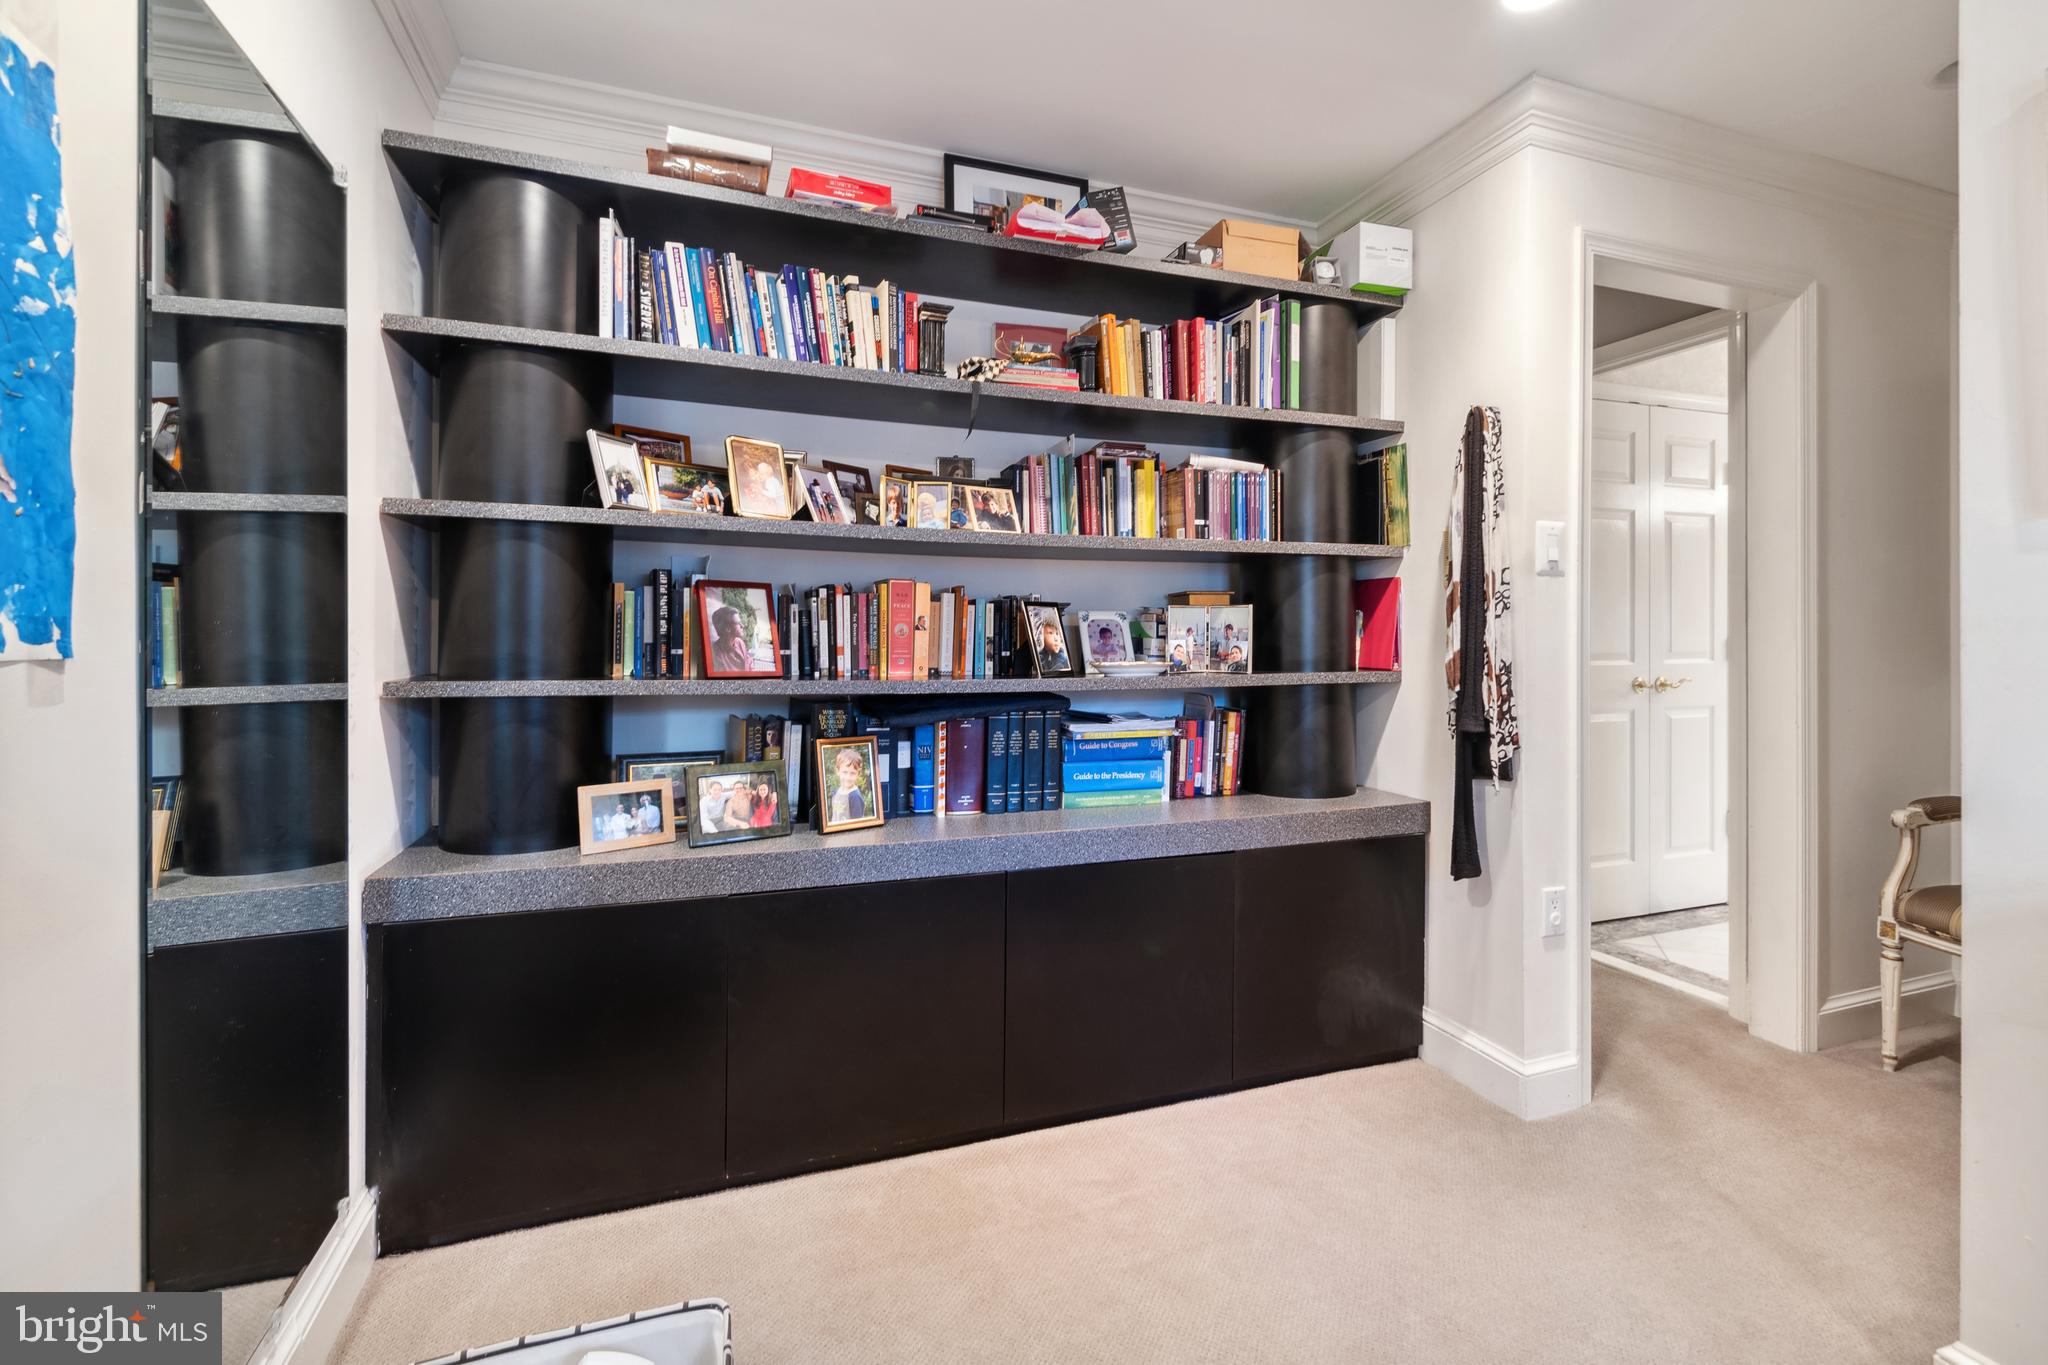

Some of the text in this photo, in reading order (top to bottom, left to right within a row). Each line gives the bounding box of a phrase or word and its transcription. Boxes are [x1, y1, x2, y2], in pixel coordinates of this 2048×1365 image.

[707, 265, 717, 280] On
[707, 280, 721, 309] Capitol
[640, 288, 652, 330] SWERVE
[713, 308, 724, 324] Hill
[917, 746, 932, 754] NIV
[1079, 742, 1099, 750] Guide
[1108, 741, 1138, 750] Congress
[1073, 772, 1093, 780] Guide
[1101, 771, 1111, 779] the
[1112, 771, 1145, 780] Presidency
